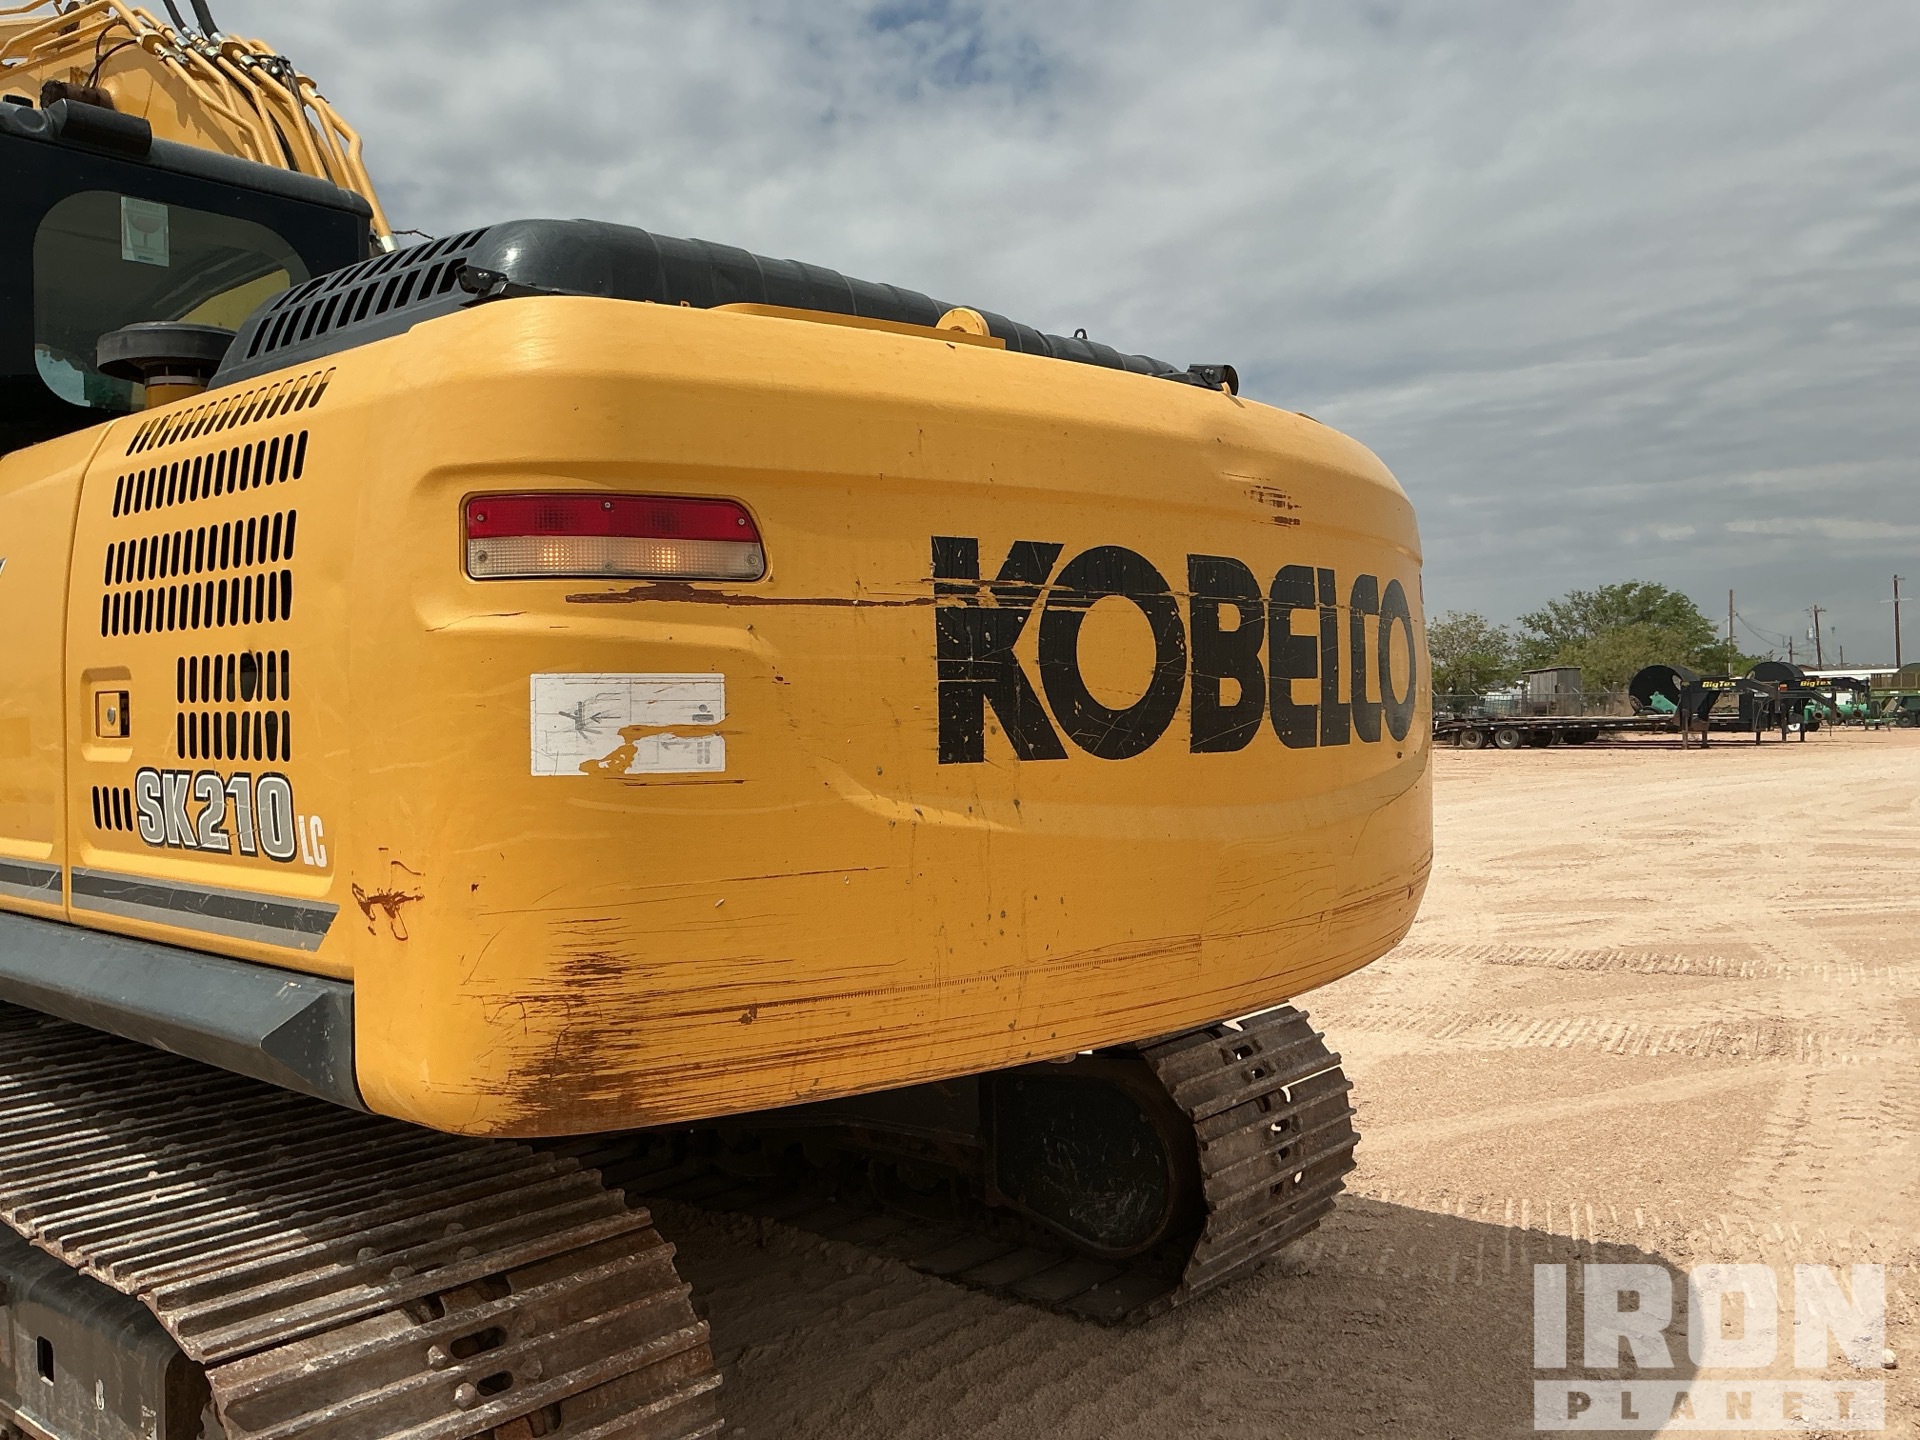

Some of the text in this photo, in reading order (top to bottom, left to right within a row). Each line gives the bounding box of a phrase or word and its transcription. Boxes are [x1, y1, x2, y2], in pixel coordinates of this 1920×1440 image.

[931, 535, 1416, 764] KOBELCO
[136, 766, 328, 868] SK210 LC
